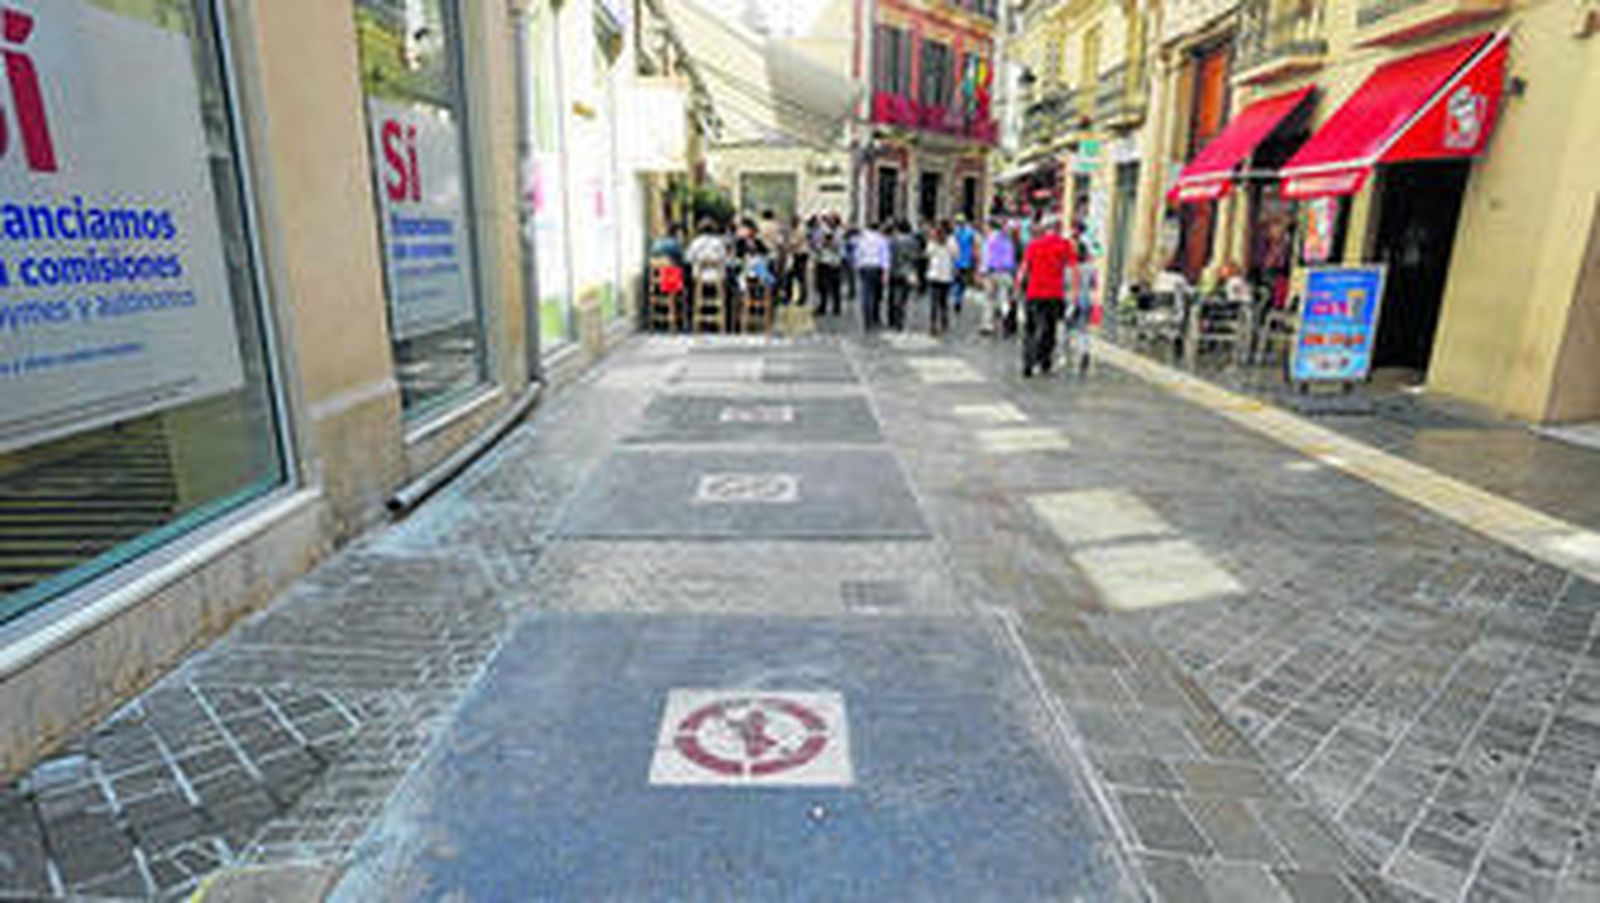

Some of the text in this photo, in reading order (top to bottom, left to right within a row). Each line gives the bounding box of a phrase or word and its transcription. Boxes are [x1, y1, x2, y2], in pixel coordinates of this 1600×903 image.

[0, 8, 58, 172] í
[0, 196, 177, 240] anciamos
[19, 247, 182, 287] comisiones
